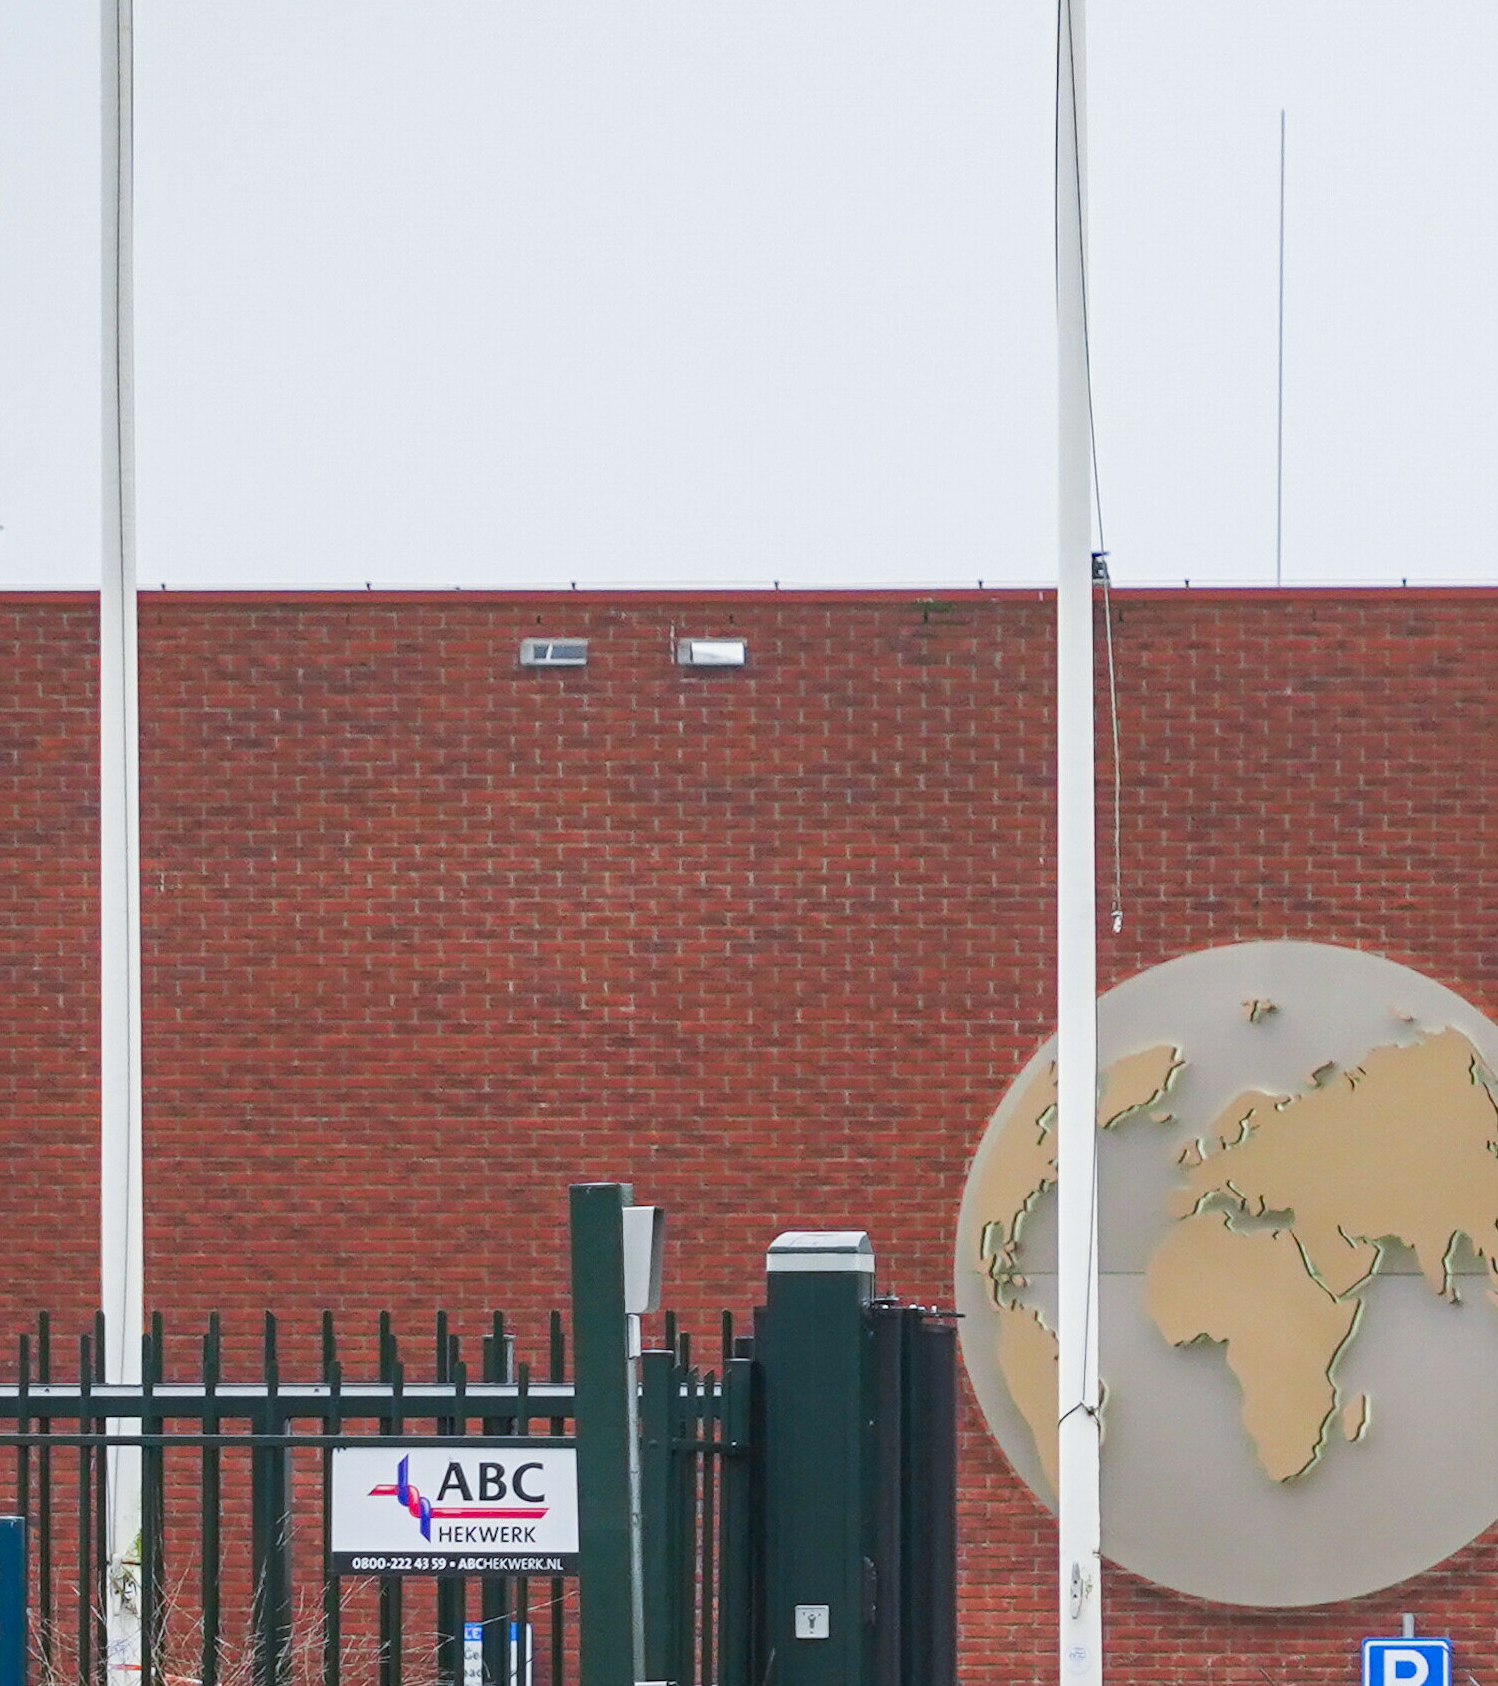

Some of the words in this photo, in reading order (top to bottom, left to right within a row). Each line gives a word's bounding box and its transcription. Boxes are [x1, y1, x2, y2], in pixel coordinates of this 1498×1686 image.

[436, 1461, 546, 1503] ABC
[438, 1526, 537, 1544] HEKWERK
[352, 1556, 412, 1571] 0800-222
[414, 1556, 430, 1571] 43
[431, 1556, 447, 1571] 59
[457, 1556, 564, 1572] ABCHEKWERK.NL
